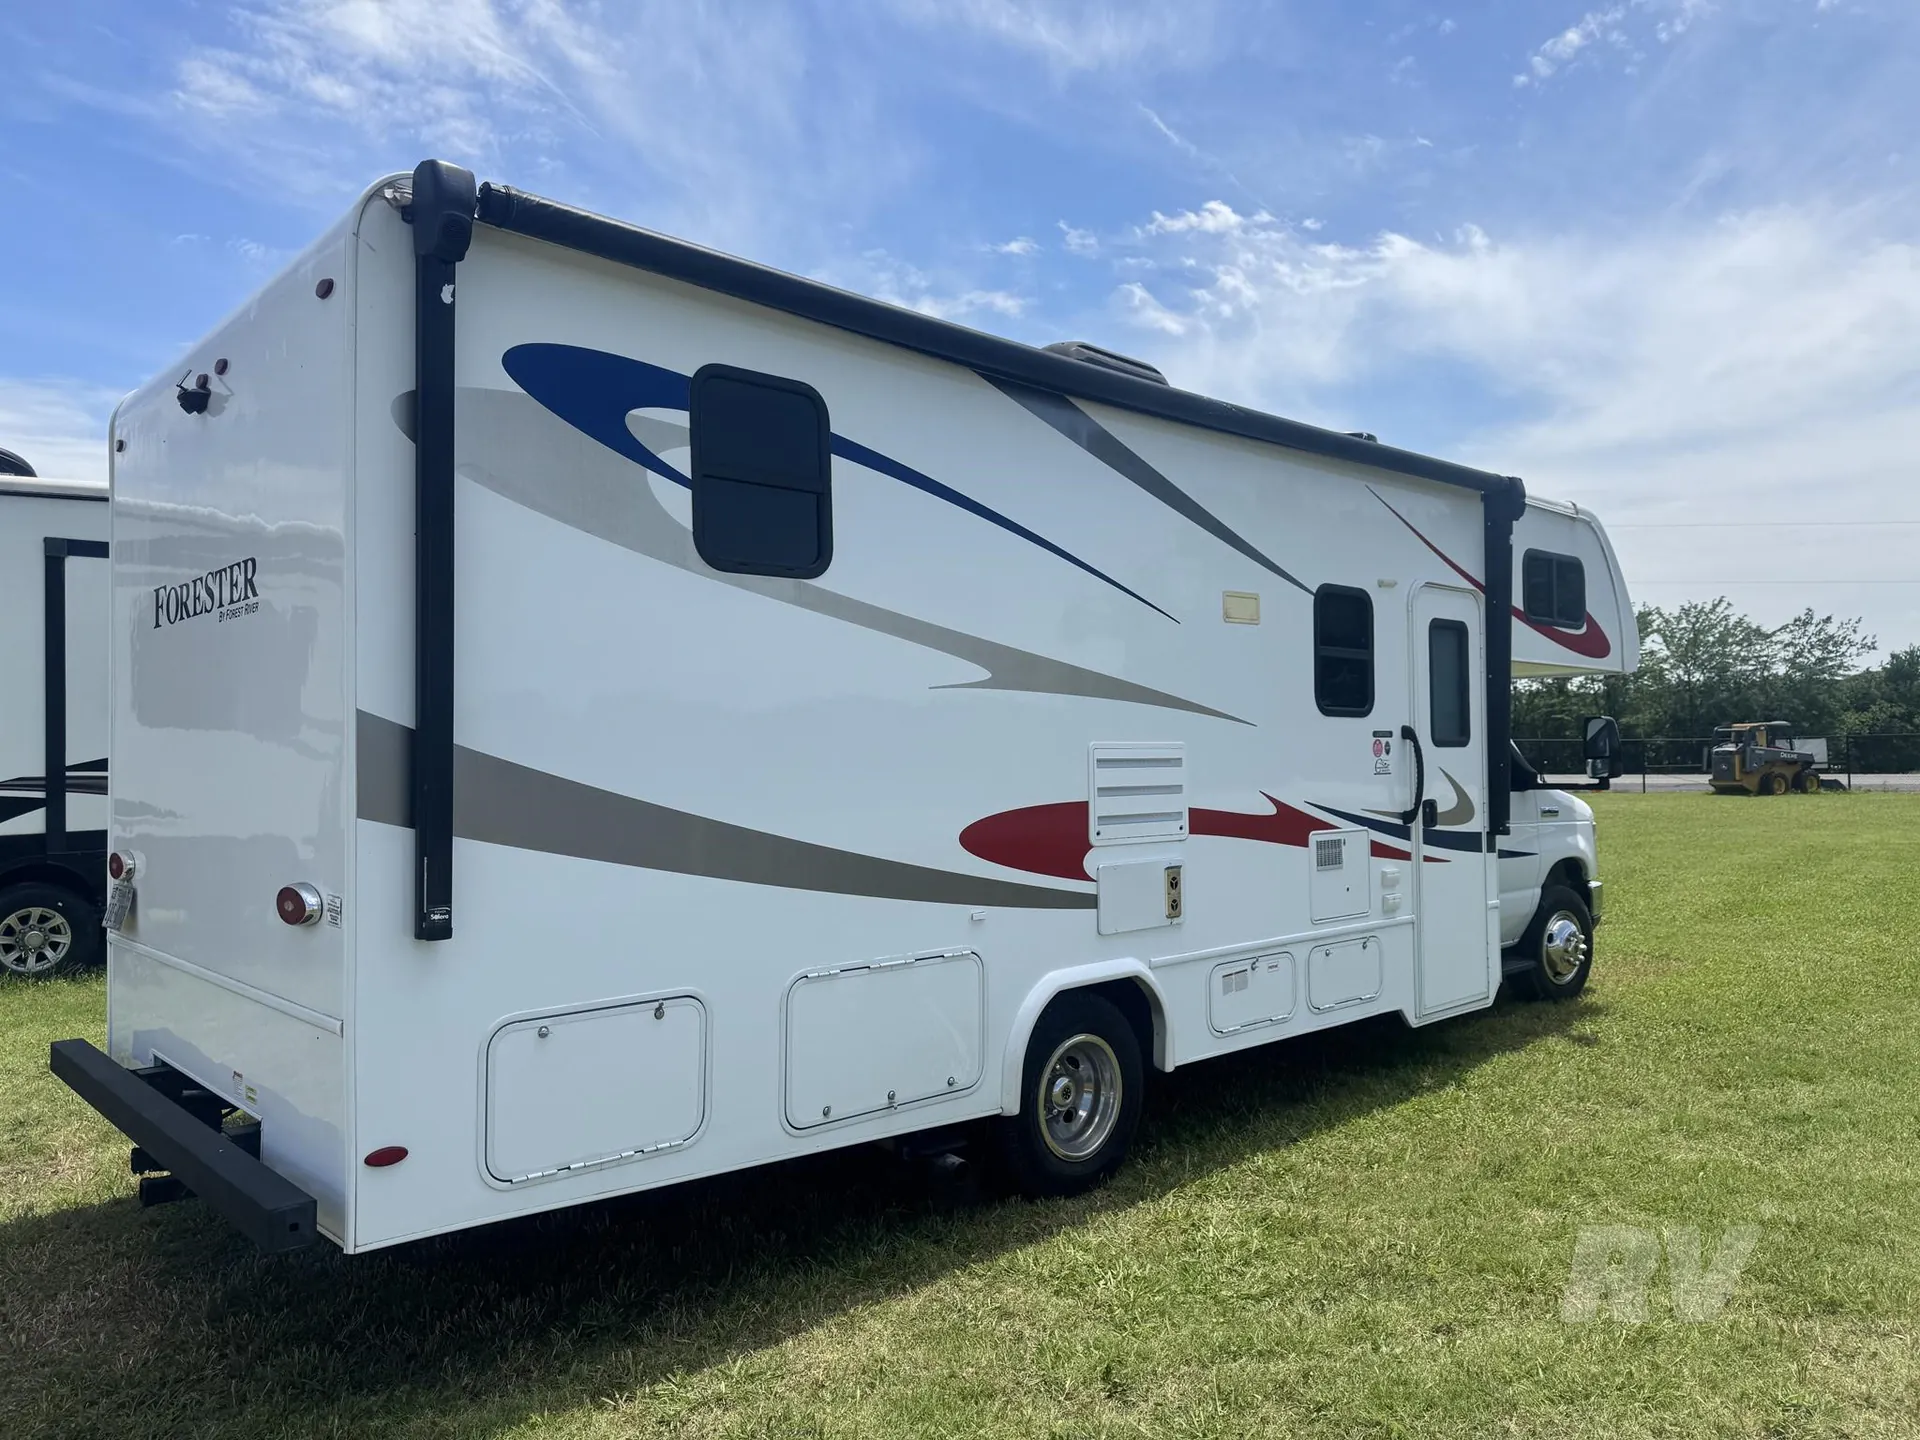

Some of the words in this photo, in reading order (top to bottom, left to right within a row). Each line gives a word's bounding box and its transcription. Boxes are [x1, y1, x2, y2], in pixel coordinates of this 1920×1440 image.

[153, 557, 259, 629] FORESTER
[218, 611, 226, 623] BY
[226, 606, 244, 621] FOREST
[244, 601, 259, 616] RIVER
